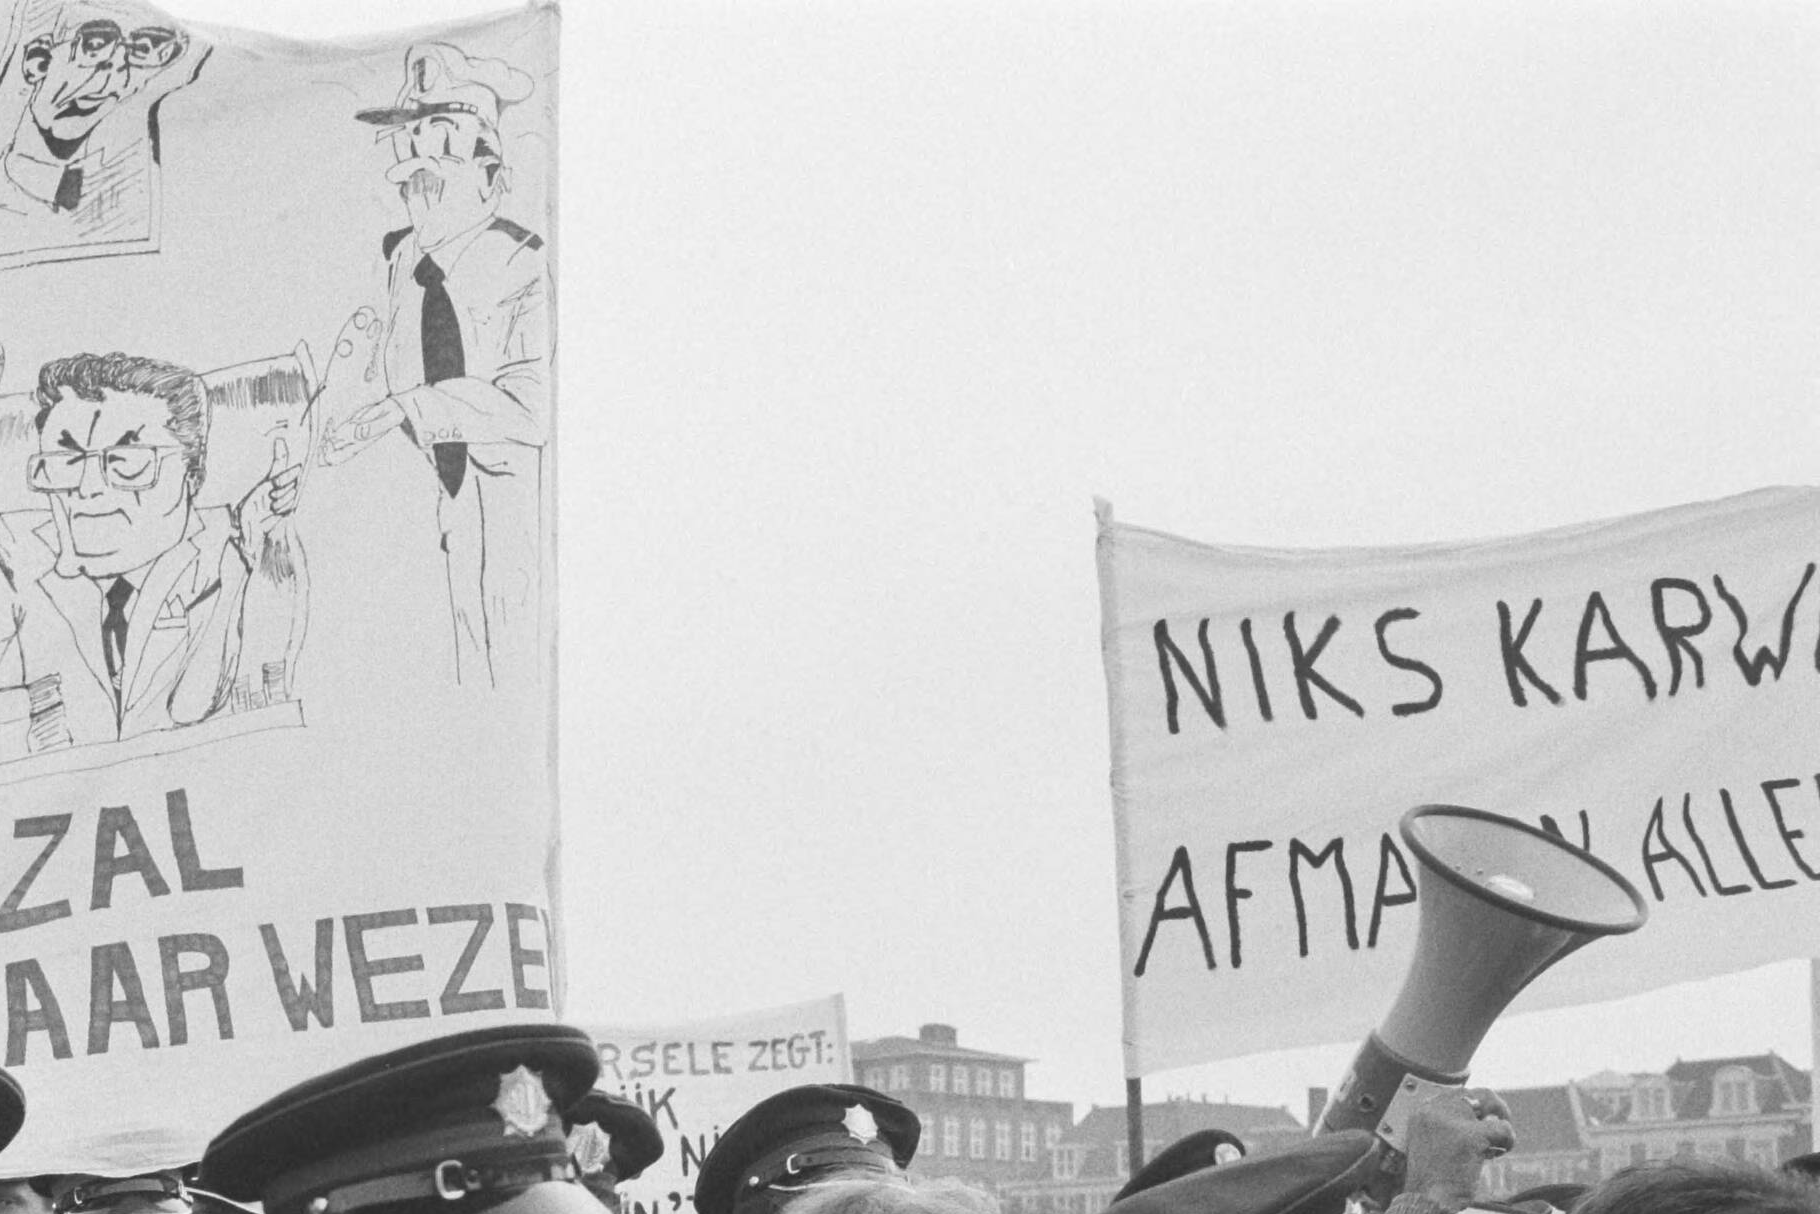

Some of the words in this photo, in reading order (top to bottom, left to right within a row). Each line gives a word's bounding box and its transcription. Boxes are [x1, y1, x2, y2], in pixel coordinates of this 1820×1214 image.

[1154, 608, 1443, 735] NIKS
[1497, 562, 1820, 706] KARW
[1642, 773, 1820, 902] ALLE
[259, 903, 553, 1032] WEZE
[747, 1029, 835, 1073] ZEGT:
